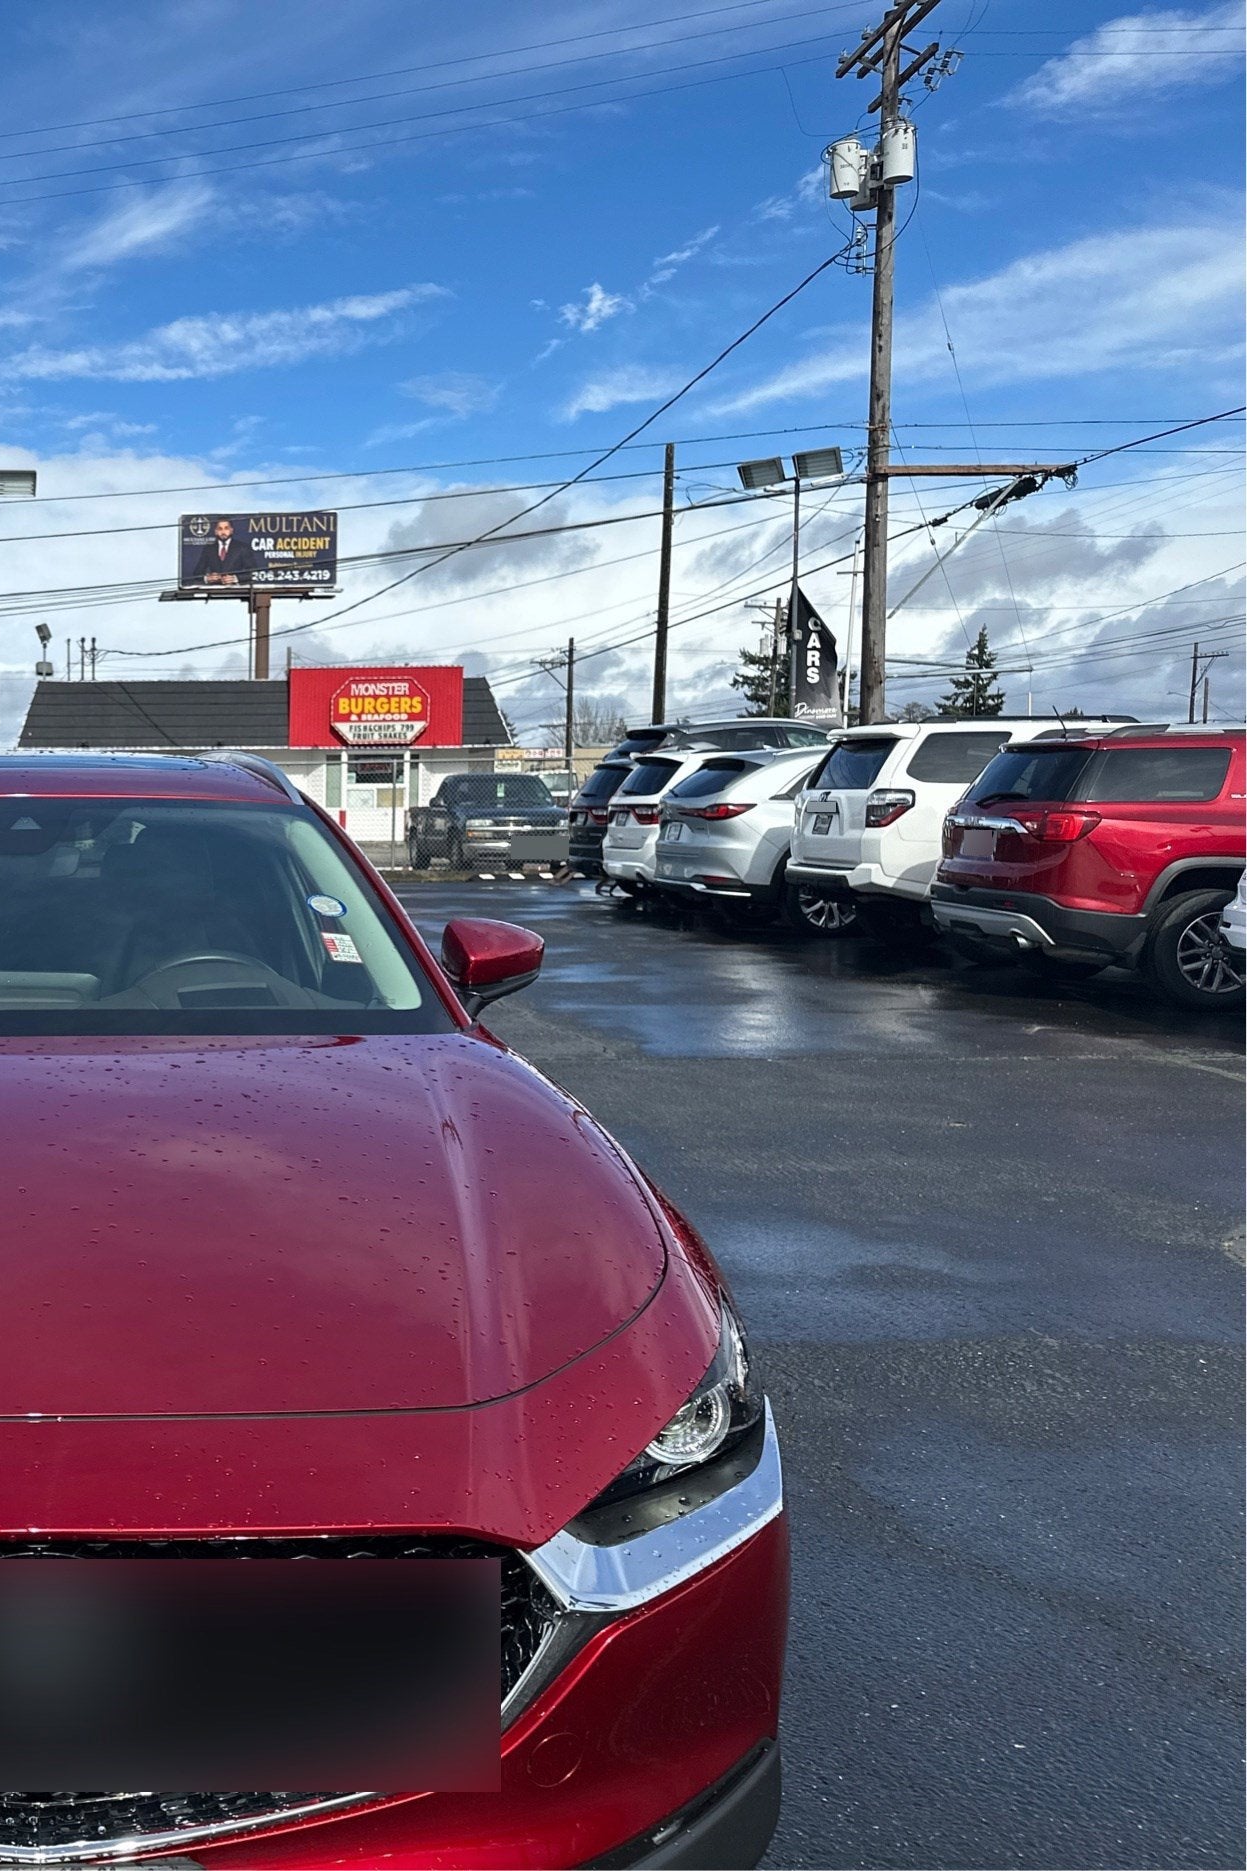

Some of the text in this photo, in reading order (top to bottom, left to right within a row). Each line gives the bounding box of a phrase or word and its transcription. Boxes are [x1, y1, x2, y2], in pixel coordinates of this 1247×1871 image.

[248, 515, 336, 533] MULTANI
[251, 537, 330, 551] CAR ACCIDENT
[264, 550, 318, 559] PERSONAL INJURY
[251, 570, 331, 582] 206.243.4219
[806, 616, 821, 683] CARS
[351, 683, 410, 696] MONSTER
[338, 696, 423, 714] BURGERS
[361, 713, 408, 721] SEAFOOD
[352, 732, 408, 740] FRUIT SHAKES
